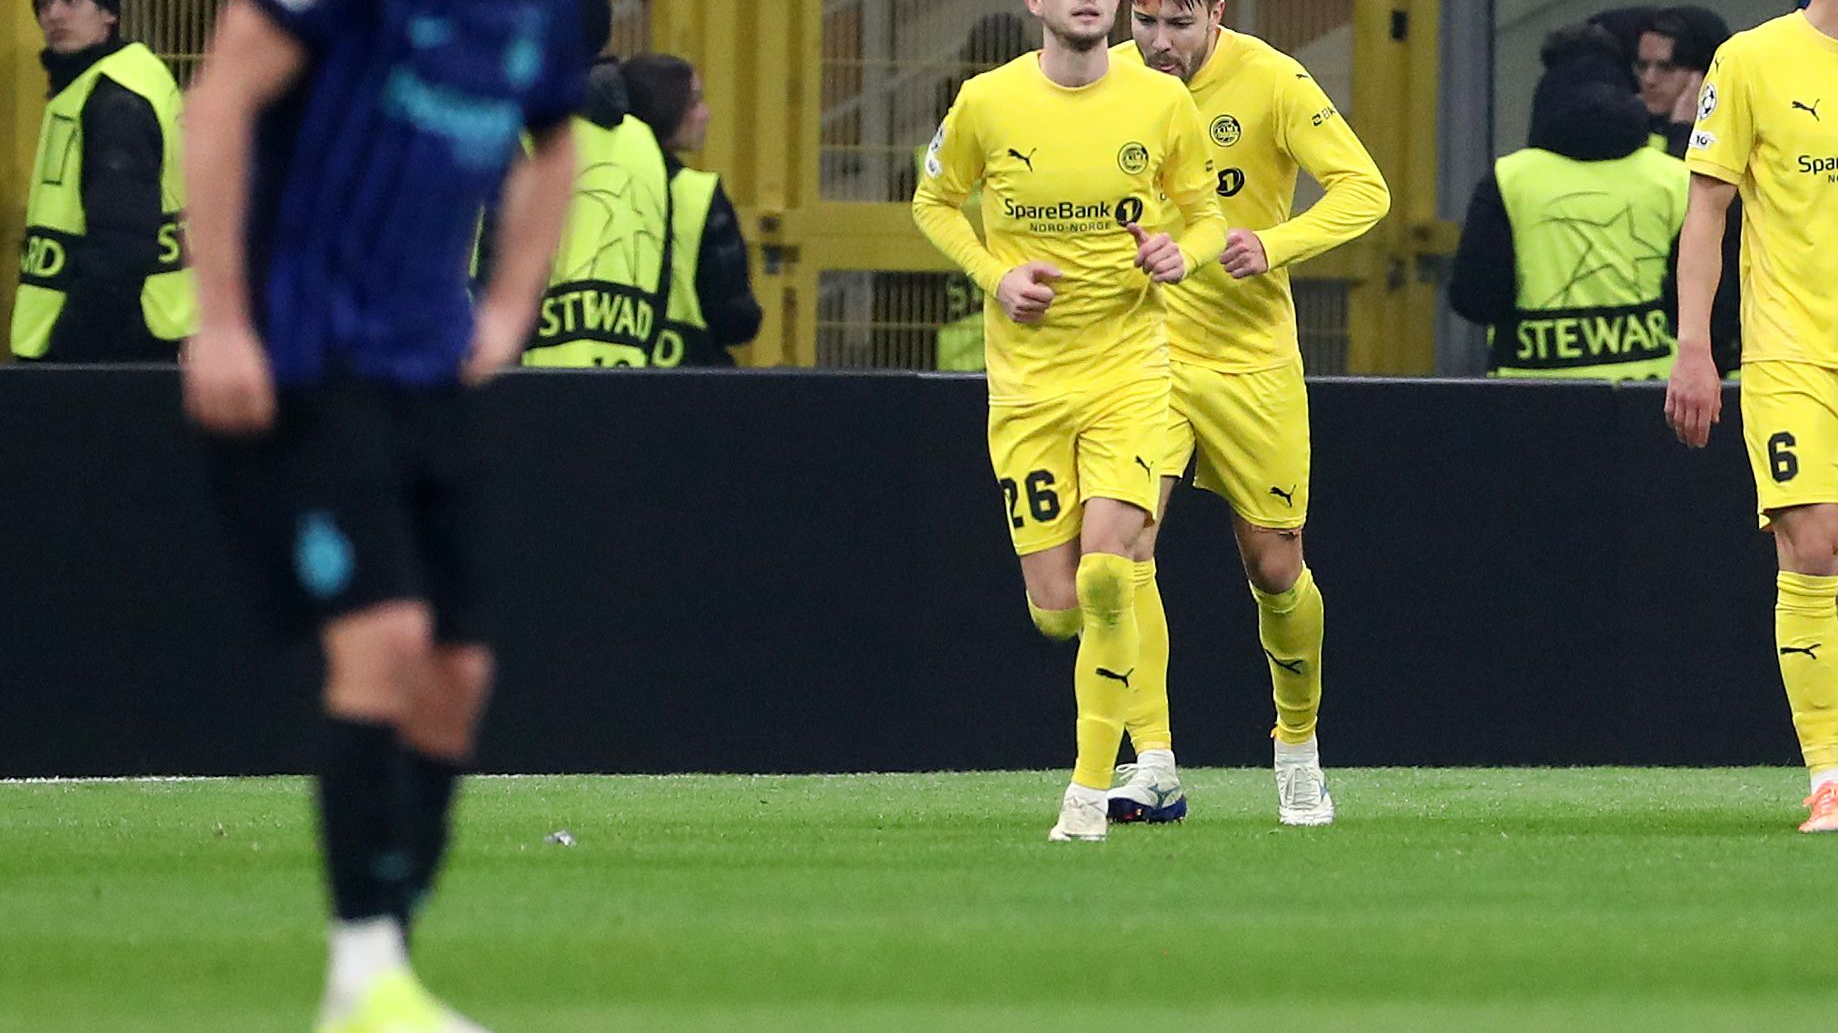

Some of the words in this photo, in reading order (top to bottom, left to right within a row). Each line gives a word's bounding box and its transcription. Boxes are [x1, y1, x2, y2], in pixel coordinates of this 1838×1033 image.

[1004, 198, 1111, 220] SpareBank
[1030, 221, 1112, 233] NORD-NORGE
[1517, 310, 1664, 359] STEWAR
[1767, 431, 1798, 484] 6
[999, 469, 1061, 529] 26
